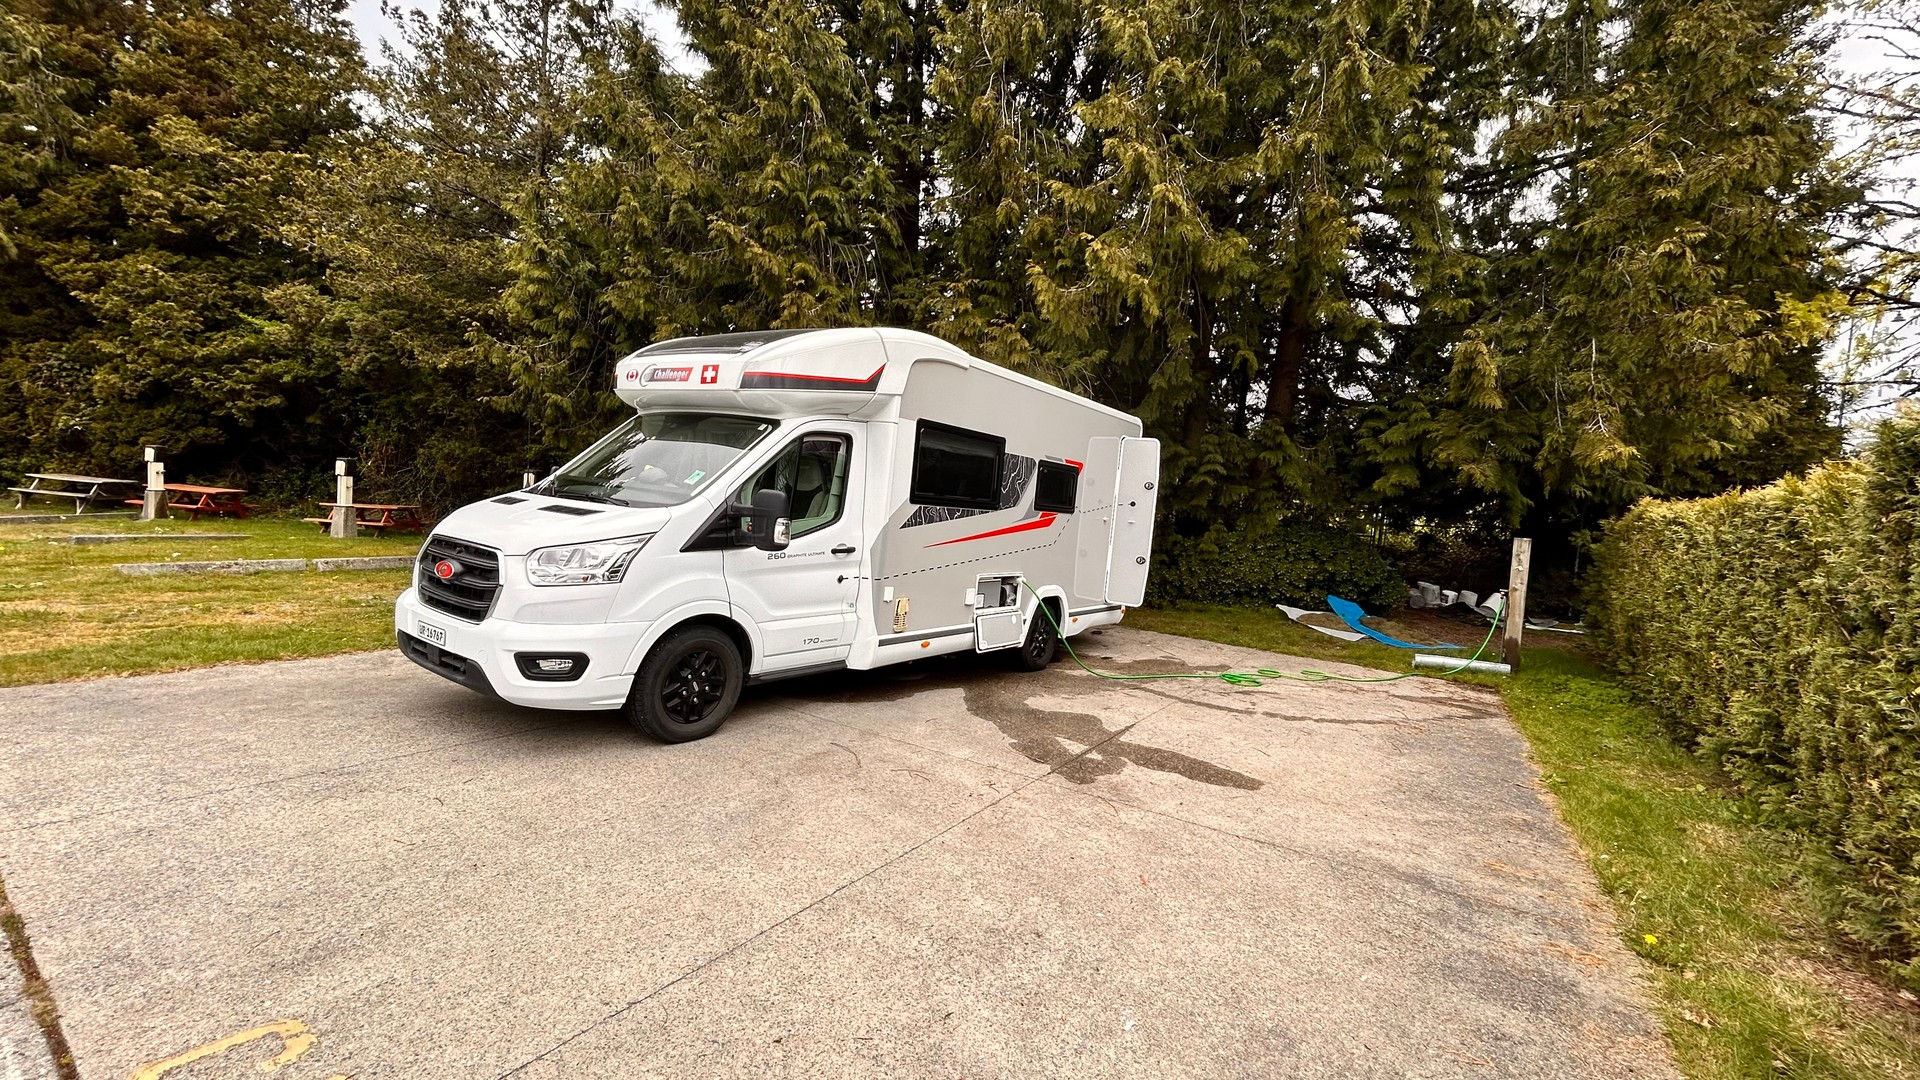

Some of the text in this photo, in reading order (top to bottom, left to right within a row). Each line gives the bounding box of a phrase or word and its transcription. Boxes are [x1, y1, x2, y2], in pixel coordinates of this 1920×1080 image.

[653, 368, 689, 381] Challenger
[767, 552, 786, 560] 260
[803, 637, 820, 645] 170
